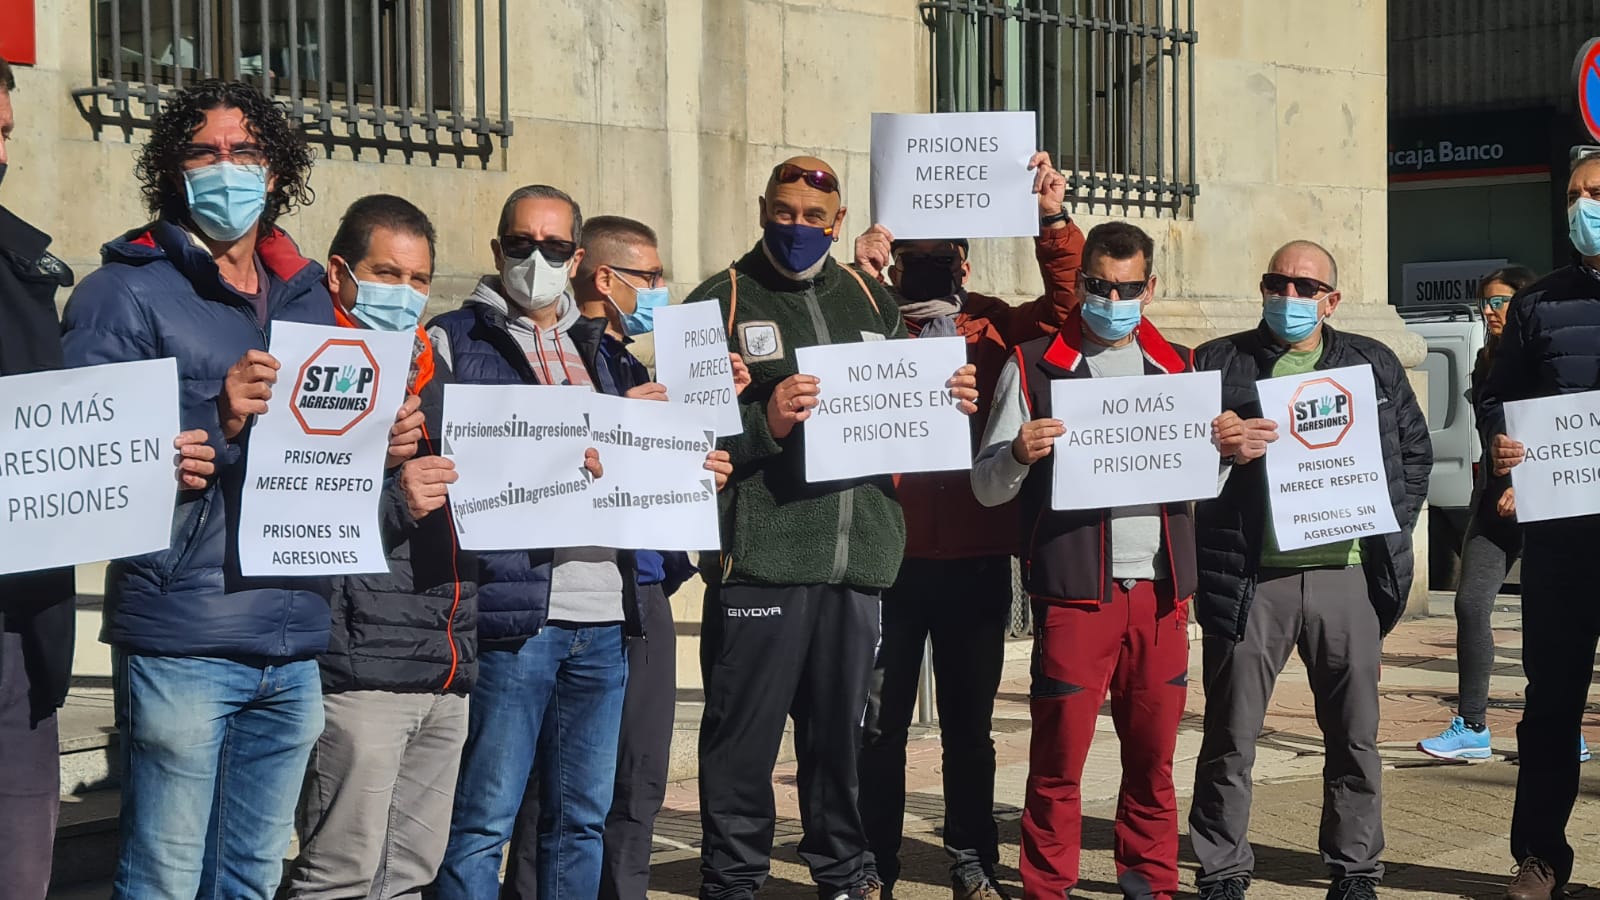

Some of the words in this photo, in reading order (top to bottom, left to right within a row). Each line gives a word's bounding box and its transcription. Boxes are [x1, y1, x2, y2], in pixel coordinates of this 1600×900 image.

[907, 136, 999, 153] PRISIONES
[1439, 141, 1504, 162] Banco
[916, 165, 989, 181] MERECE
[912, 192, 990, 209] RESPETO
[1416, 279, 1462, 301] SOMOS
[684, 327, 726, 349] PRISION
[689, 356, 729, 379] MERECE
[848, 364, 872, 383] NO
[877, 358, 918, 381] MÁS
[303, 365, 374, 394] STP
[299, 395, 368, 411] AGRESIONES
[684, 387, 731, 406] RESPETO
[817, 391, 923, 415] AGRESIONES
[929, 390, 953, 407] EN
[1102, 398, 1129, 415] NO
[1135, 392, 1175, 413] MÁS
[15, 403, 52, 430] NO
[61, 392, 115, 426] MÁS
[1294, 394, 1347, 421] STP
[843, 421, 929, 443] PRISIONES
[1297, 415, 1348, 432] AGRESIONES
[1555, 414, 1583, 431] NO
[591, 424, 709, 452] nessinagresiones
[1068, 424, 1178, 447] AGRESIONES
[1183, 422, 1206, 439] EN
[130, 437, 160, 463] EN
[284, 450, 353, 465] PRISIONES
[1093, 452, 1182, 475] PRISIONES
[1298, 456, 1355, 472] PRISIONES
[256, 476, 309, 490] MERECE
[315, 477, 373, 492] RESPETO
[1280, 478, 1324, 494] MERECE
[1330, 471, 1379, 487] RESPETO
[1552, 467, 1600, 486] PRISI
[8, 485, 129, 522] PRISIONES
[1293, 508, 1352, 525] PRISIONES
[1356, 504, 1377, 516] SIN
[263, 524, 332, 538] PRISIONES
[338, 525, 361, 538] SIN
[1304, 521, 1376, 540] AGRESIONES
[272, 551, 358, 564] AGRESIONES
[728, 606, 781, 617] GIVOVA
